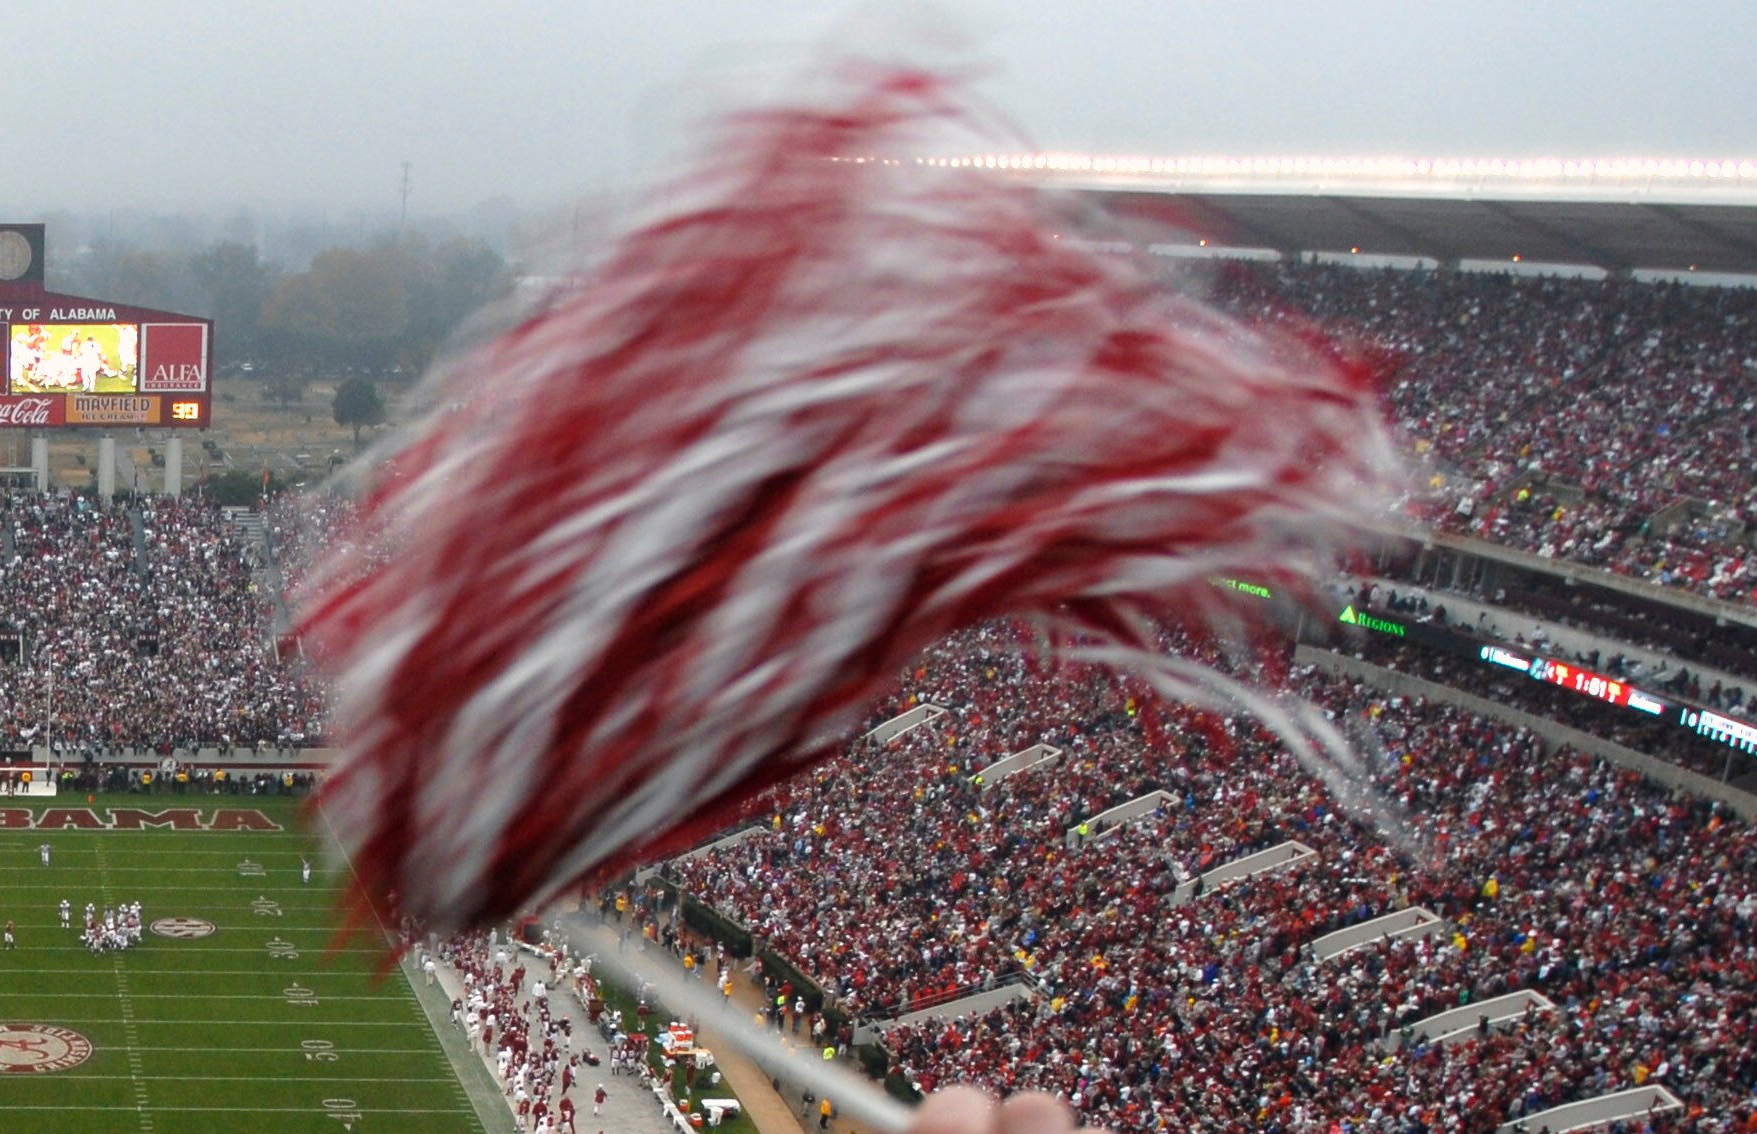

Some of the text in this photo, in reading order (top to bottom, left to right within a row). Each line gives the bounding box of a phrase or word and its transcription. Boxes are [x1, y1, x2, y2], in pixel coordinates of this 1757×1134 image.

[22, 308, 41, 320] OF
[50, 308, 117, 320] ALABAMA
[152, 364, 201, 381] ALFA
[75, 398, 150, 412] MAYFIELD
[1238, 582, 1271, 599] more.
[237, 863, 266, 877] 10
[251, 900, 283, 917] 20
[266, 940, 300, 960] 30
[283, 987, 319, 1007] 40
[300, 1039, 339, 1062] 50
[322, 1098, 362, 1122] 40
